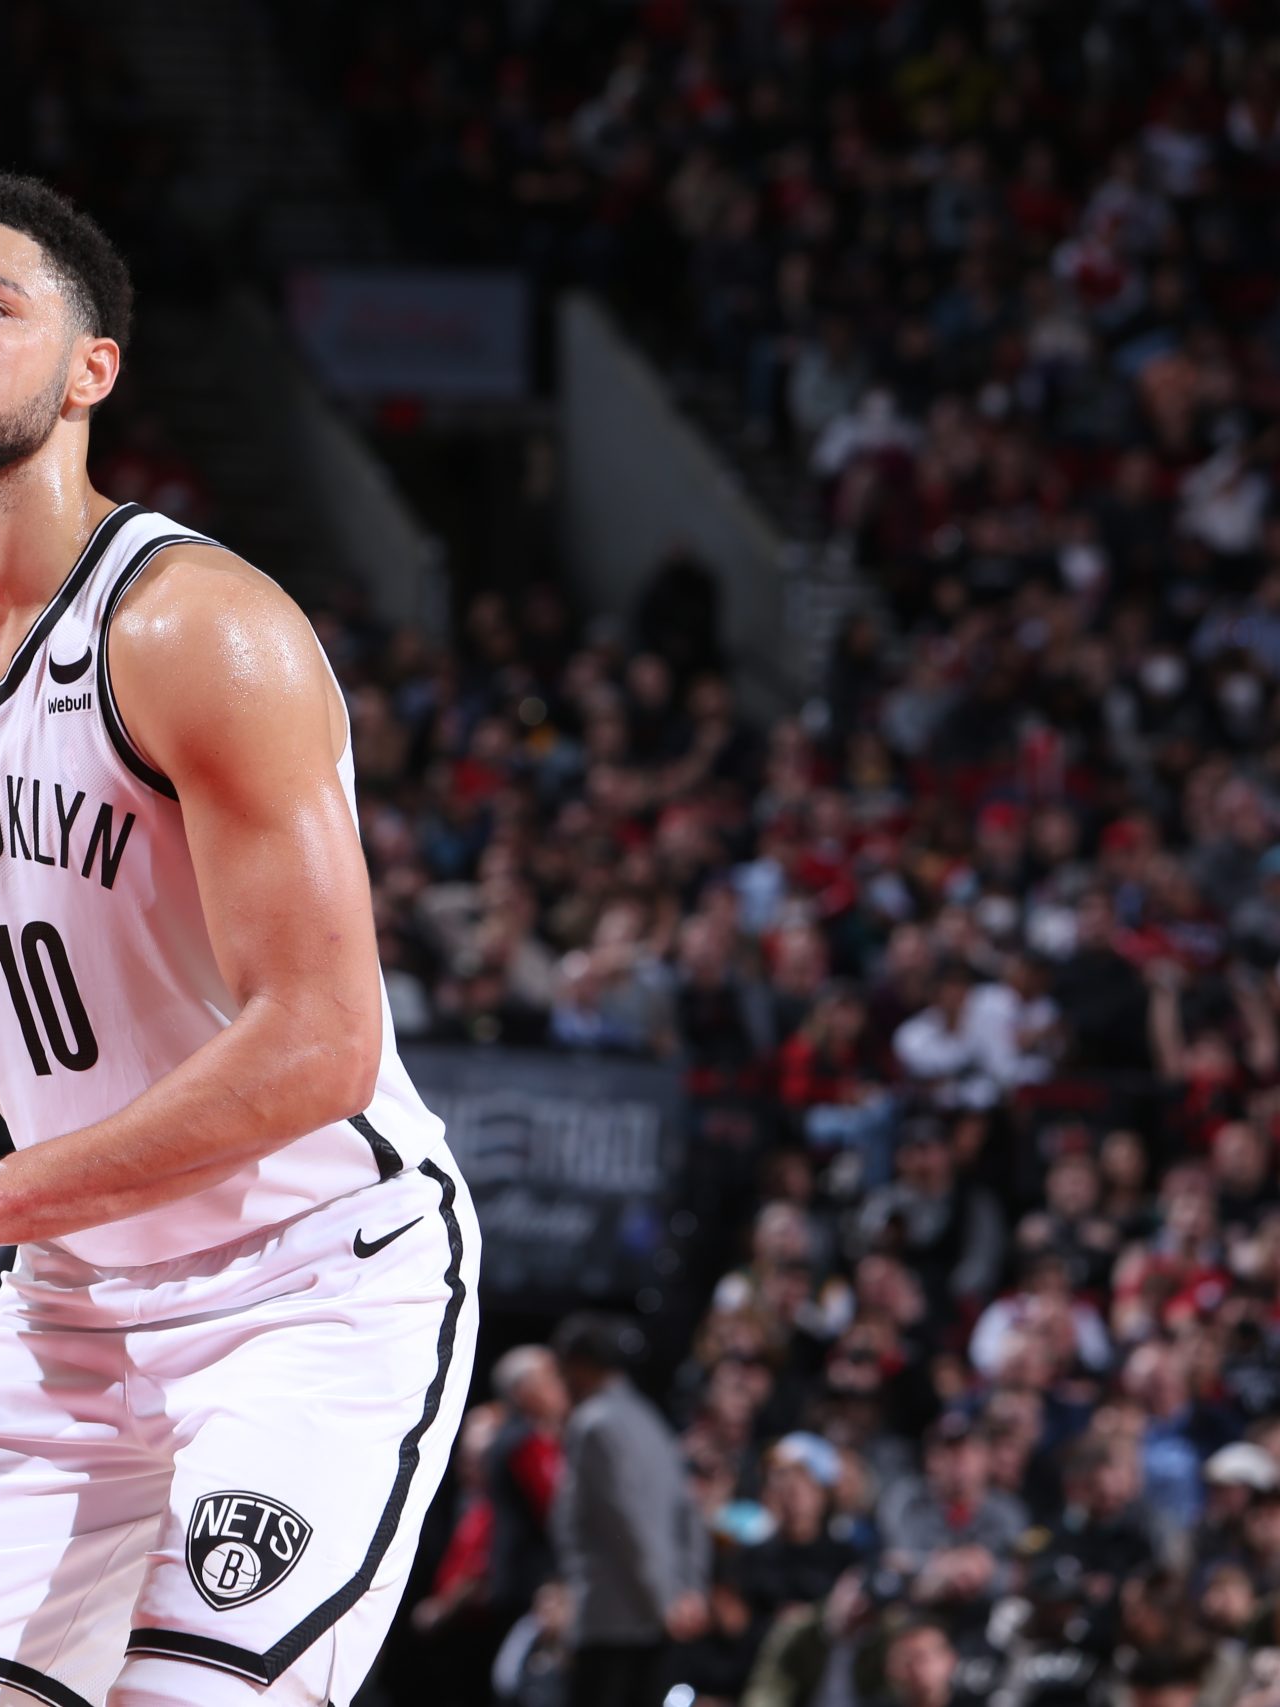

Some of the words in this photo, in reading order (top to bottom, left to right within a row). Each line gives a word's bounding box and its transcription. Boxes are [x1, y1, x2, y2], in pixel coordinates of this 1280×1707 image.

[47, 693, 92, 714] Webull
[193, 1498, 300, 1562] NETS
[217, 1549, 244, 1590] B
